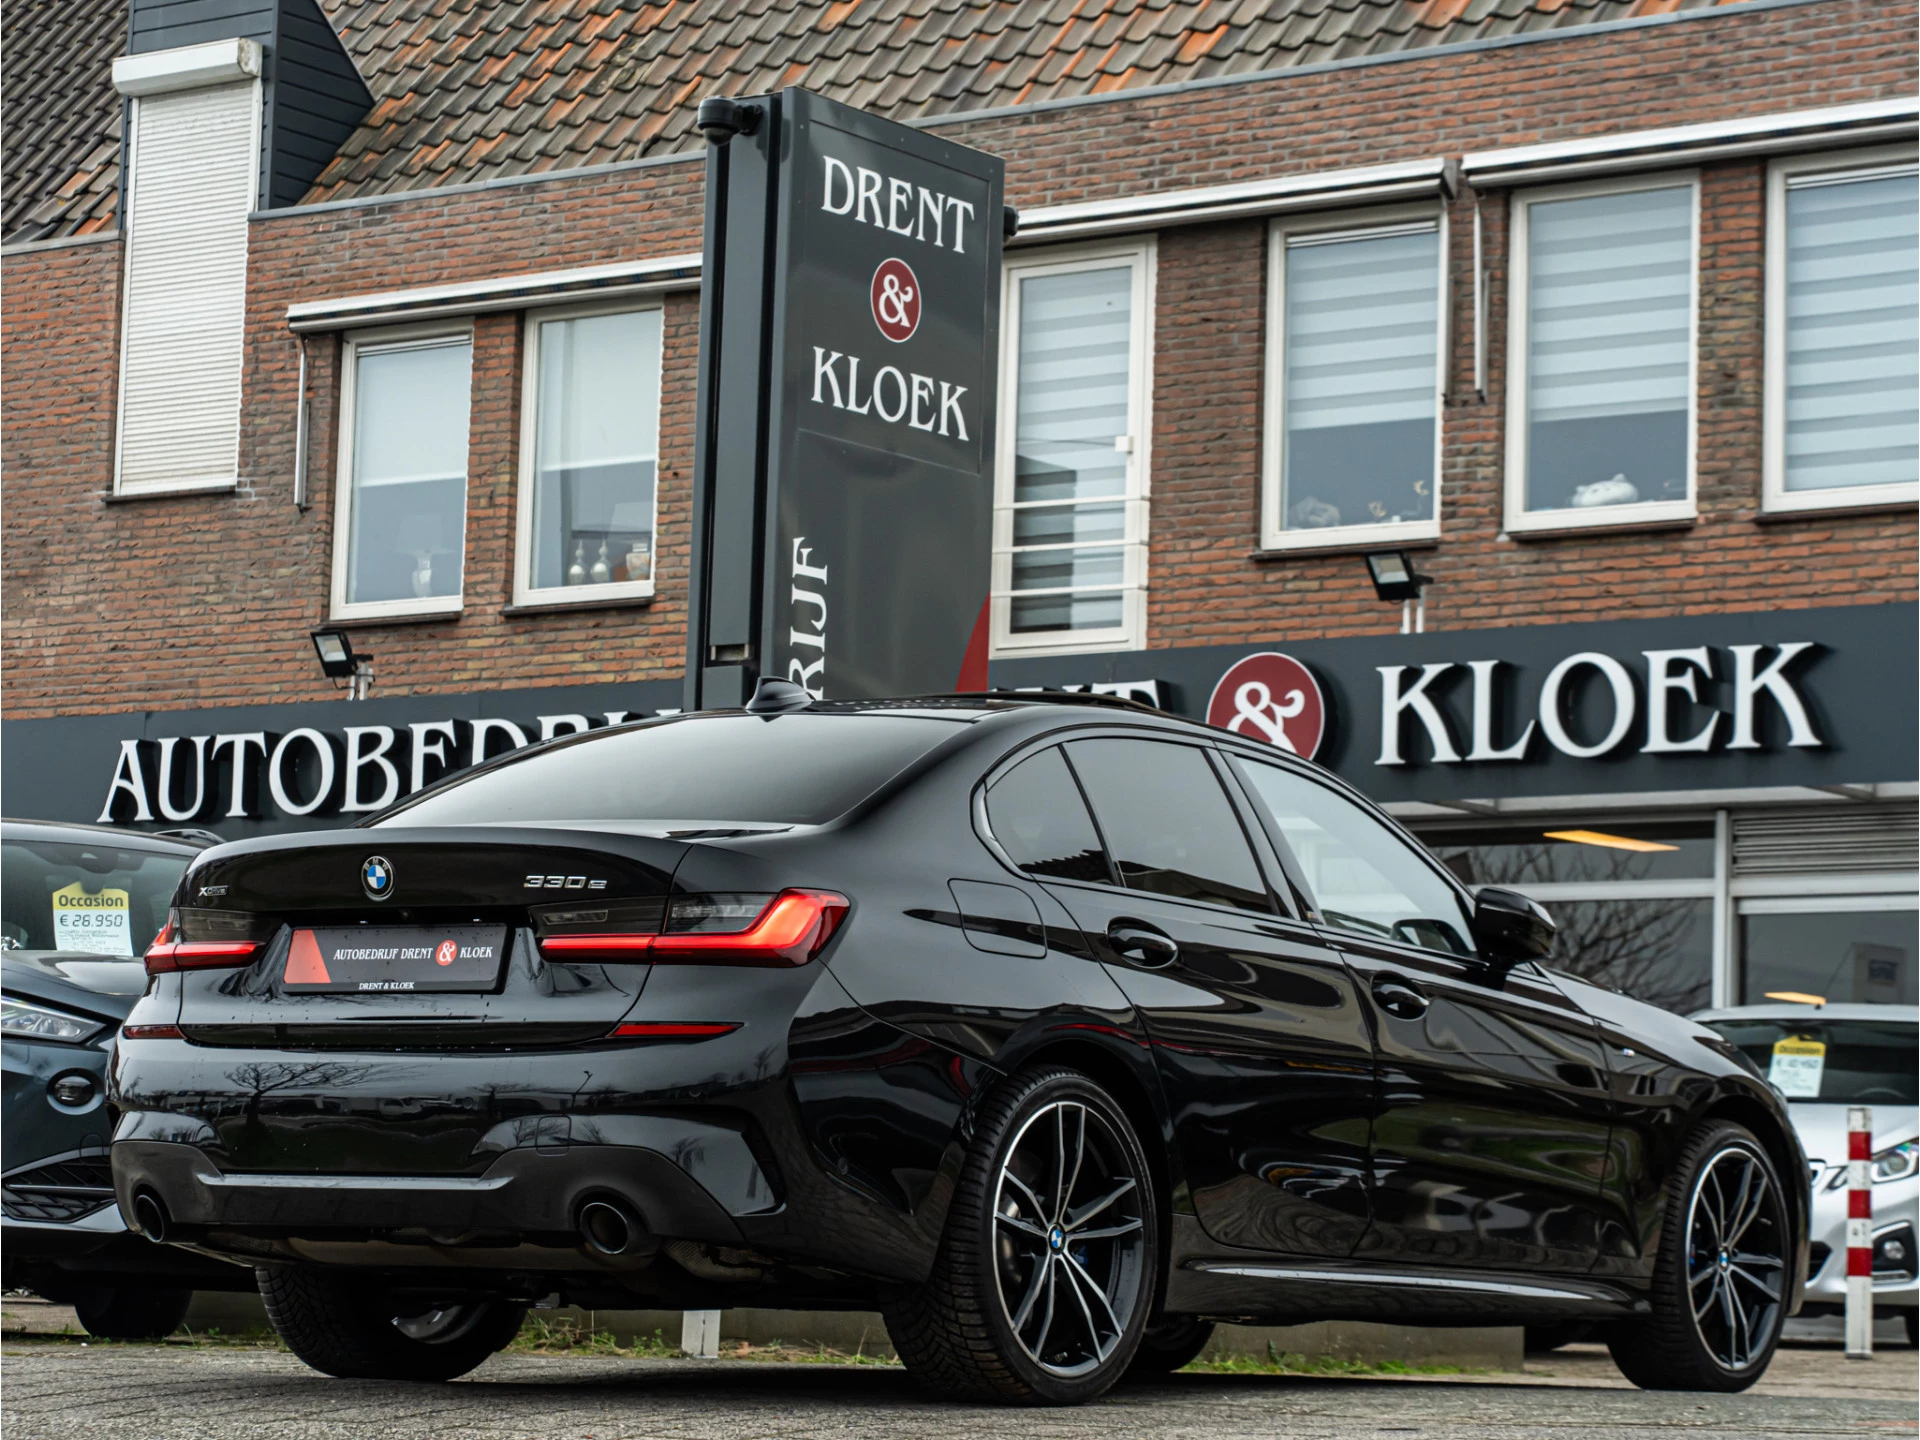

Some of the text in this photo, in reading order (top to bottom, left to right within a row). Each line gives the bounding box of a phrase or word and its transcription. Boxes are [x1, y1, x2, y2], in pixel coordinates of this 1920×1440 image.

[821, 155, 975, 254] DRENT
[879, 274, 914, 328] &
[811, 346, 970, 442] KLOEK
[96, 709, 682, 823] AUTOBE
[1374, 642, 1823, 765] KLOEK
[58, 894, 124, 907] Occasion
[60, 914, 69, 927] €
[333, 942, 493, 963] AUTOBEDRIJF DRENT & KLOEK
[358, 981, 415, 991] DRENT & KLOEK
